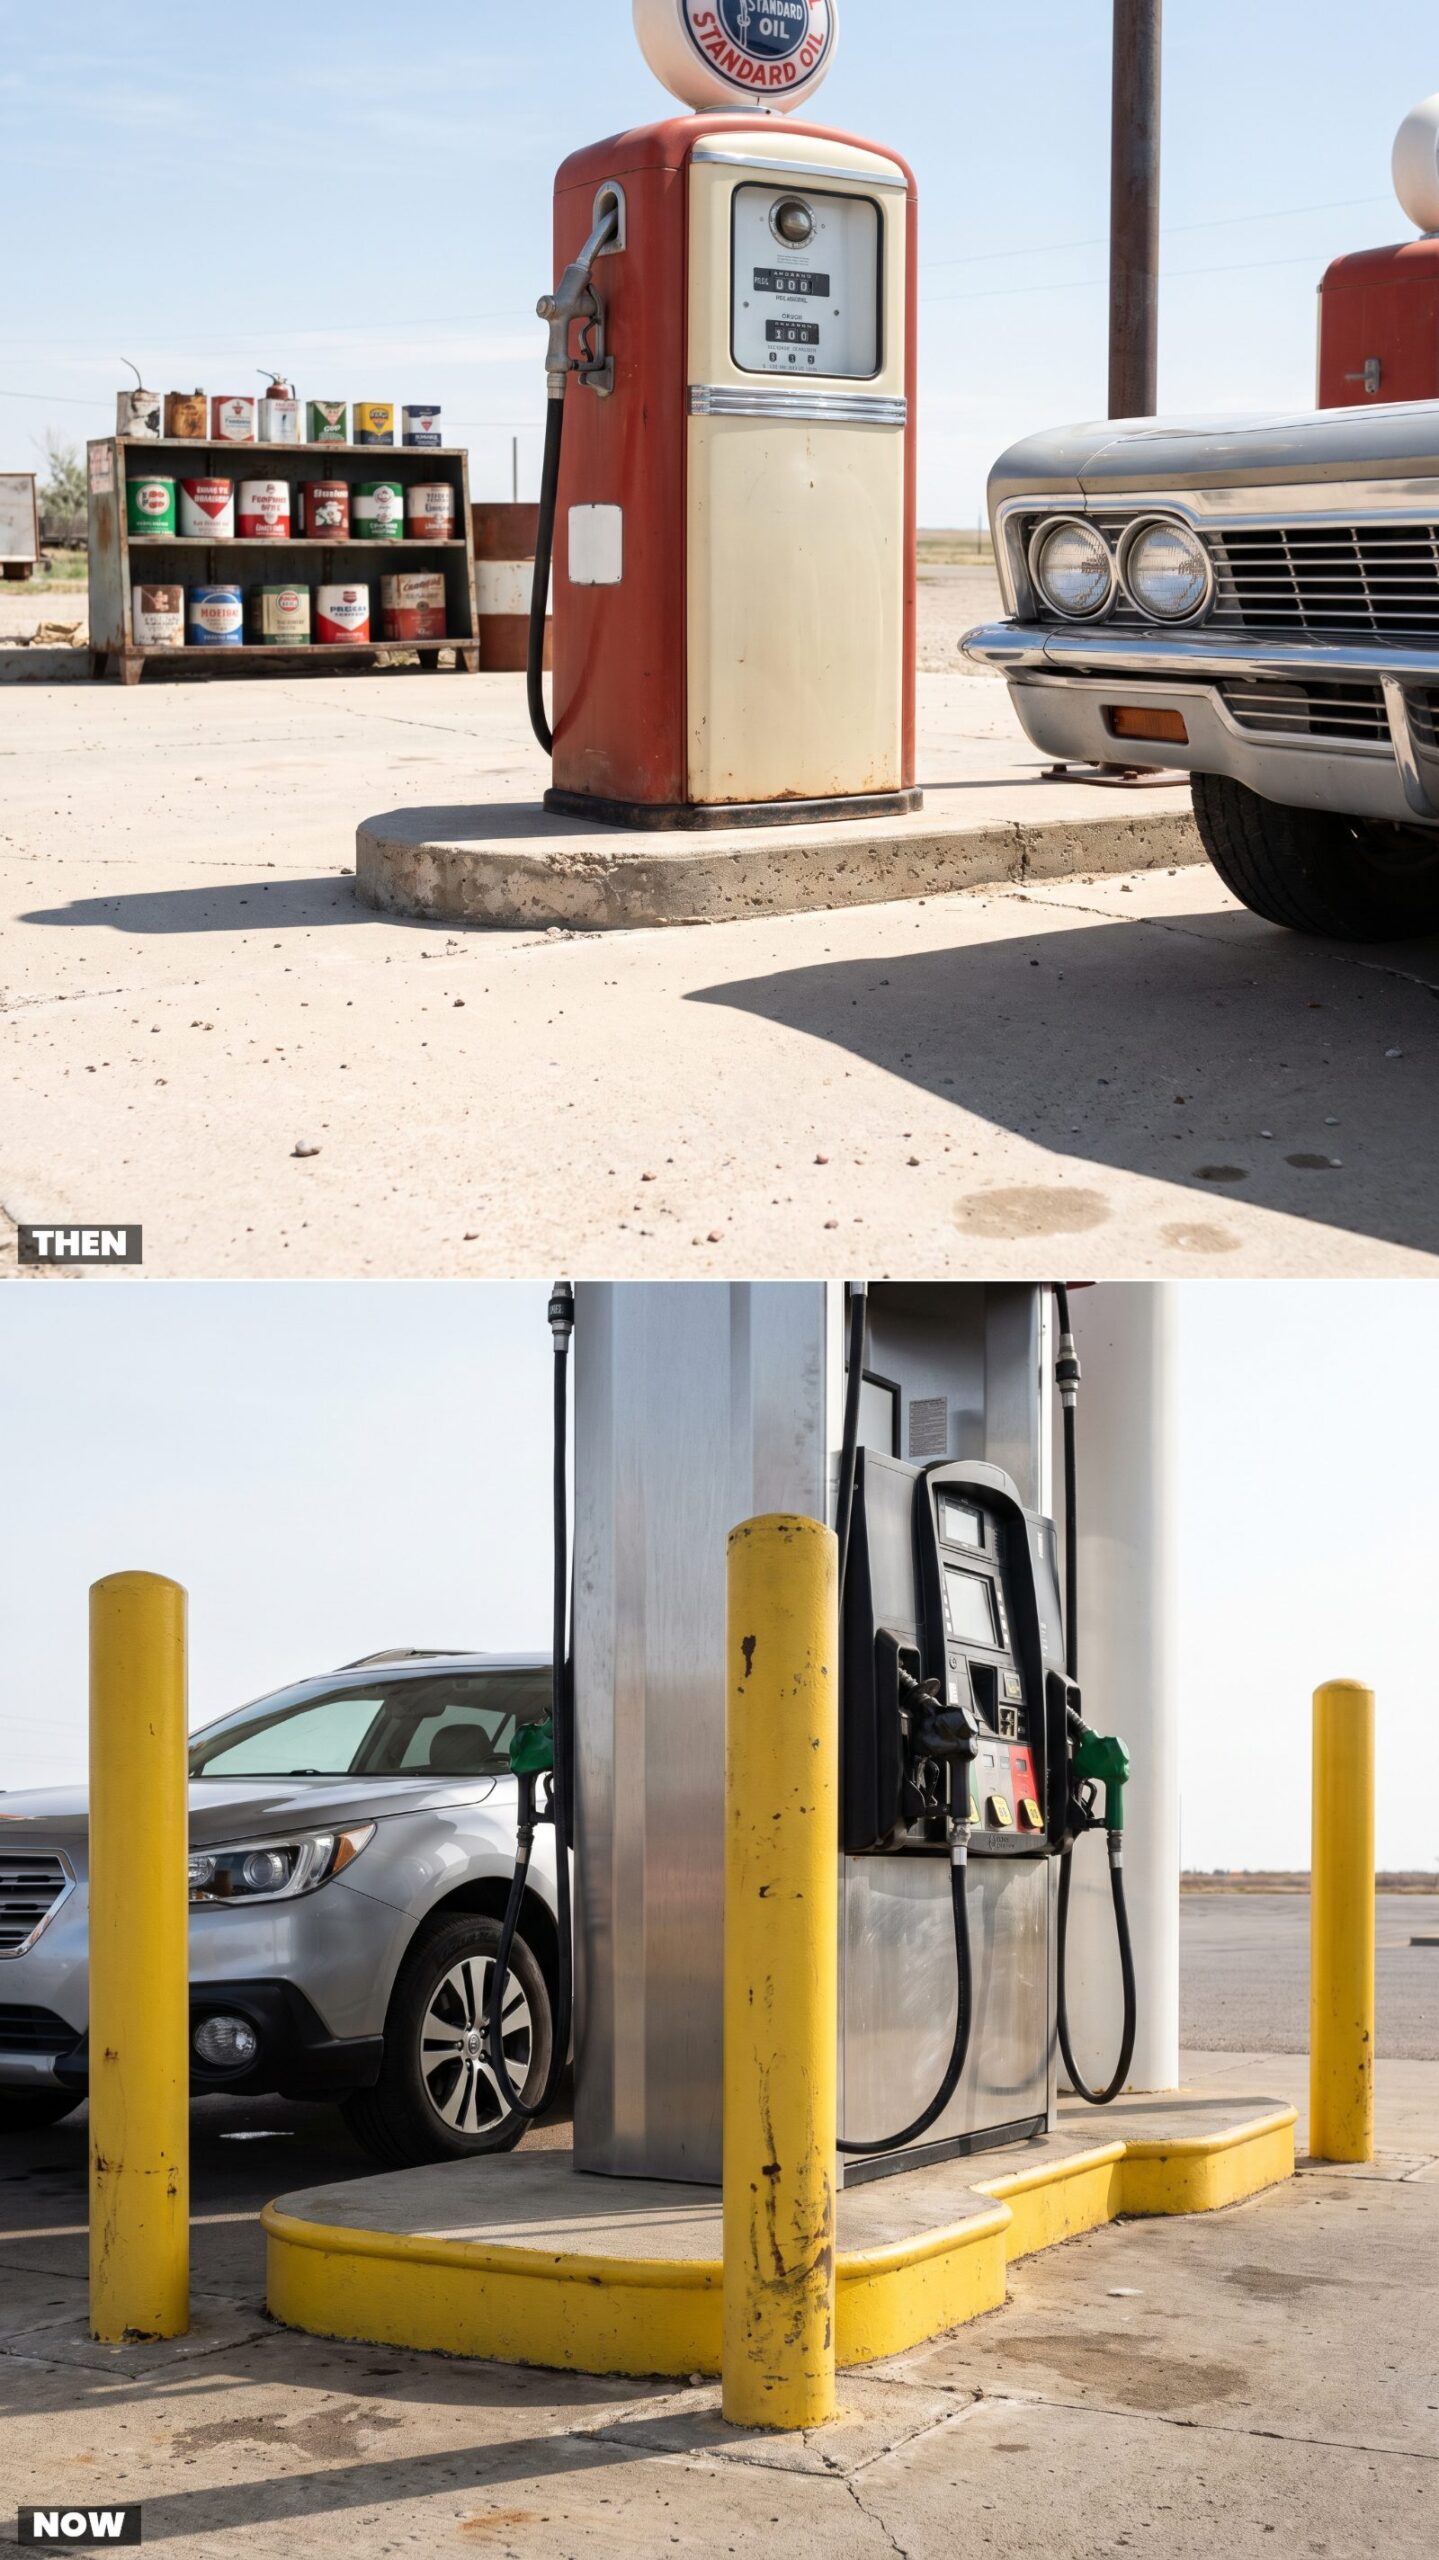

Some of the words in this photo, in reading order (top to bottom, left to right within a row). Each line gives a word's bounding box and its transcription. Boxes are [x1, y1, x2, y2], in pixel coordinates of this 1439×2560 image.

[748, 0, 803, 20] STANDARD
[759, 17, 789, 39] OIL
[692, 12, 796, 85] STANDARD
[800, 33, 824, 67] OIL
